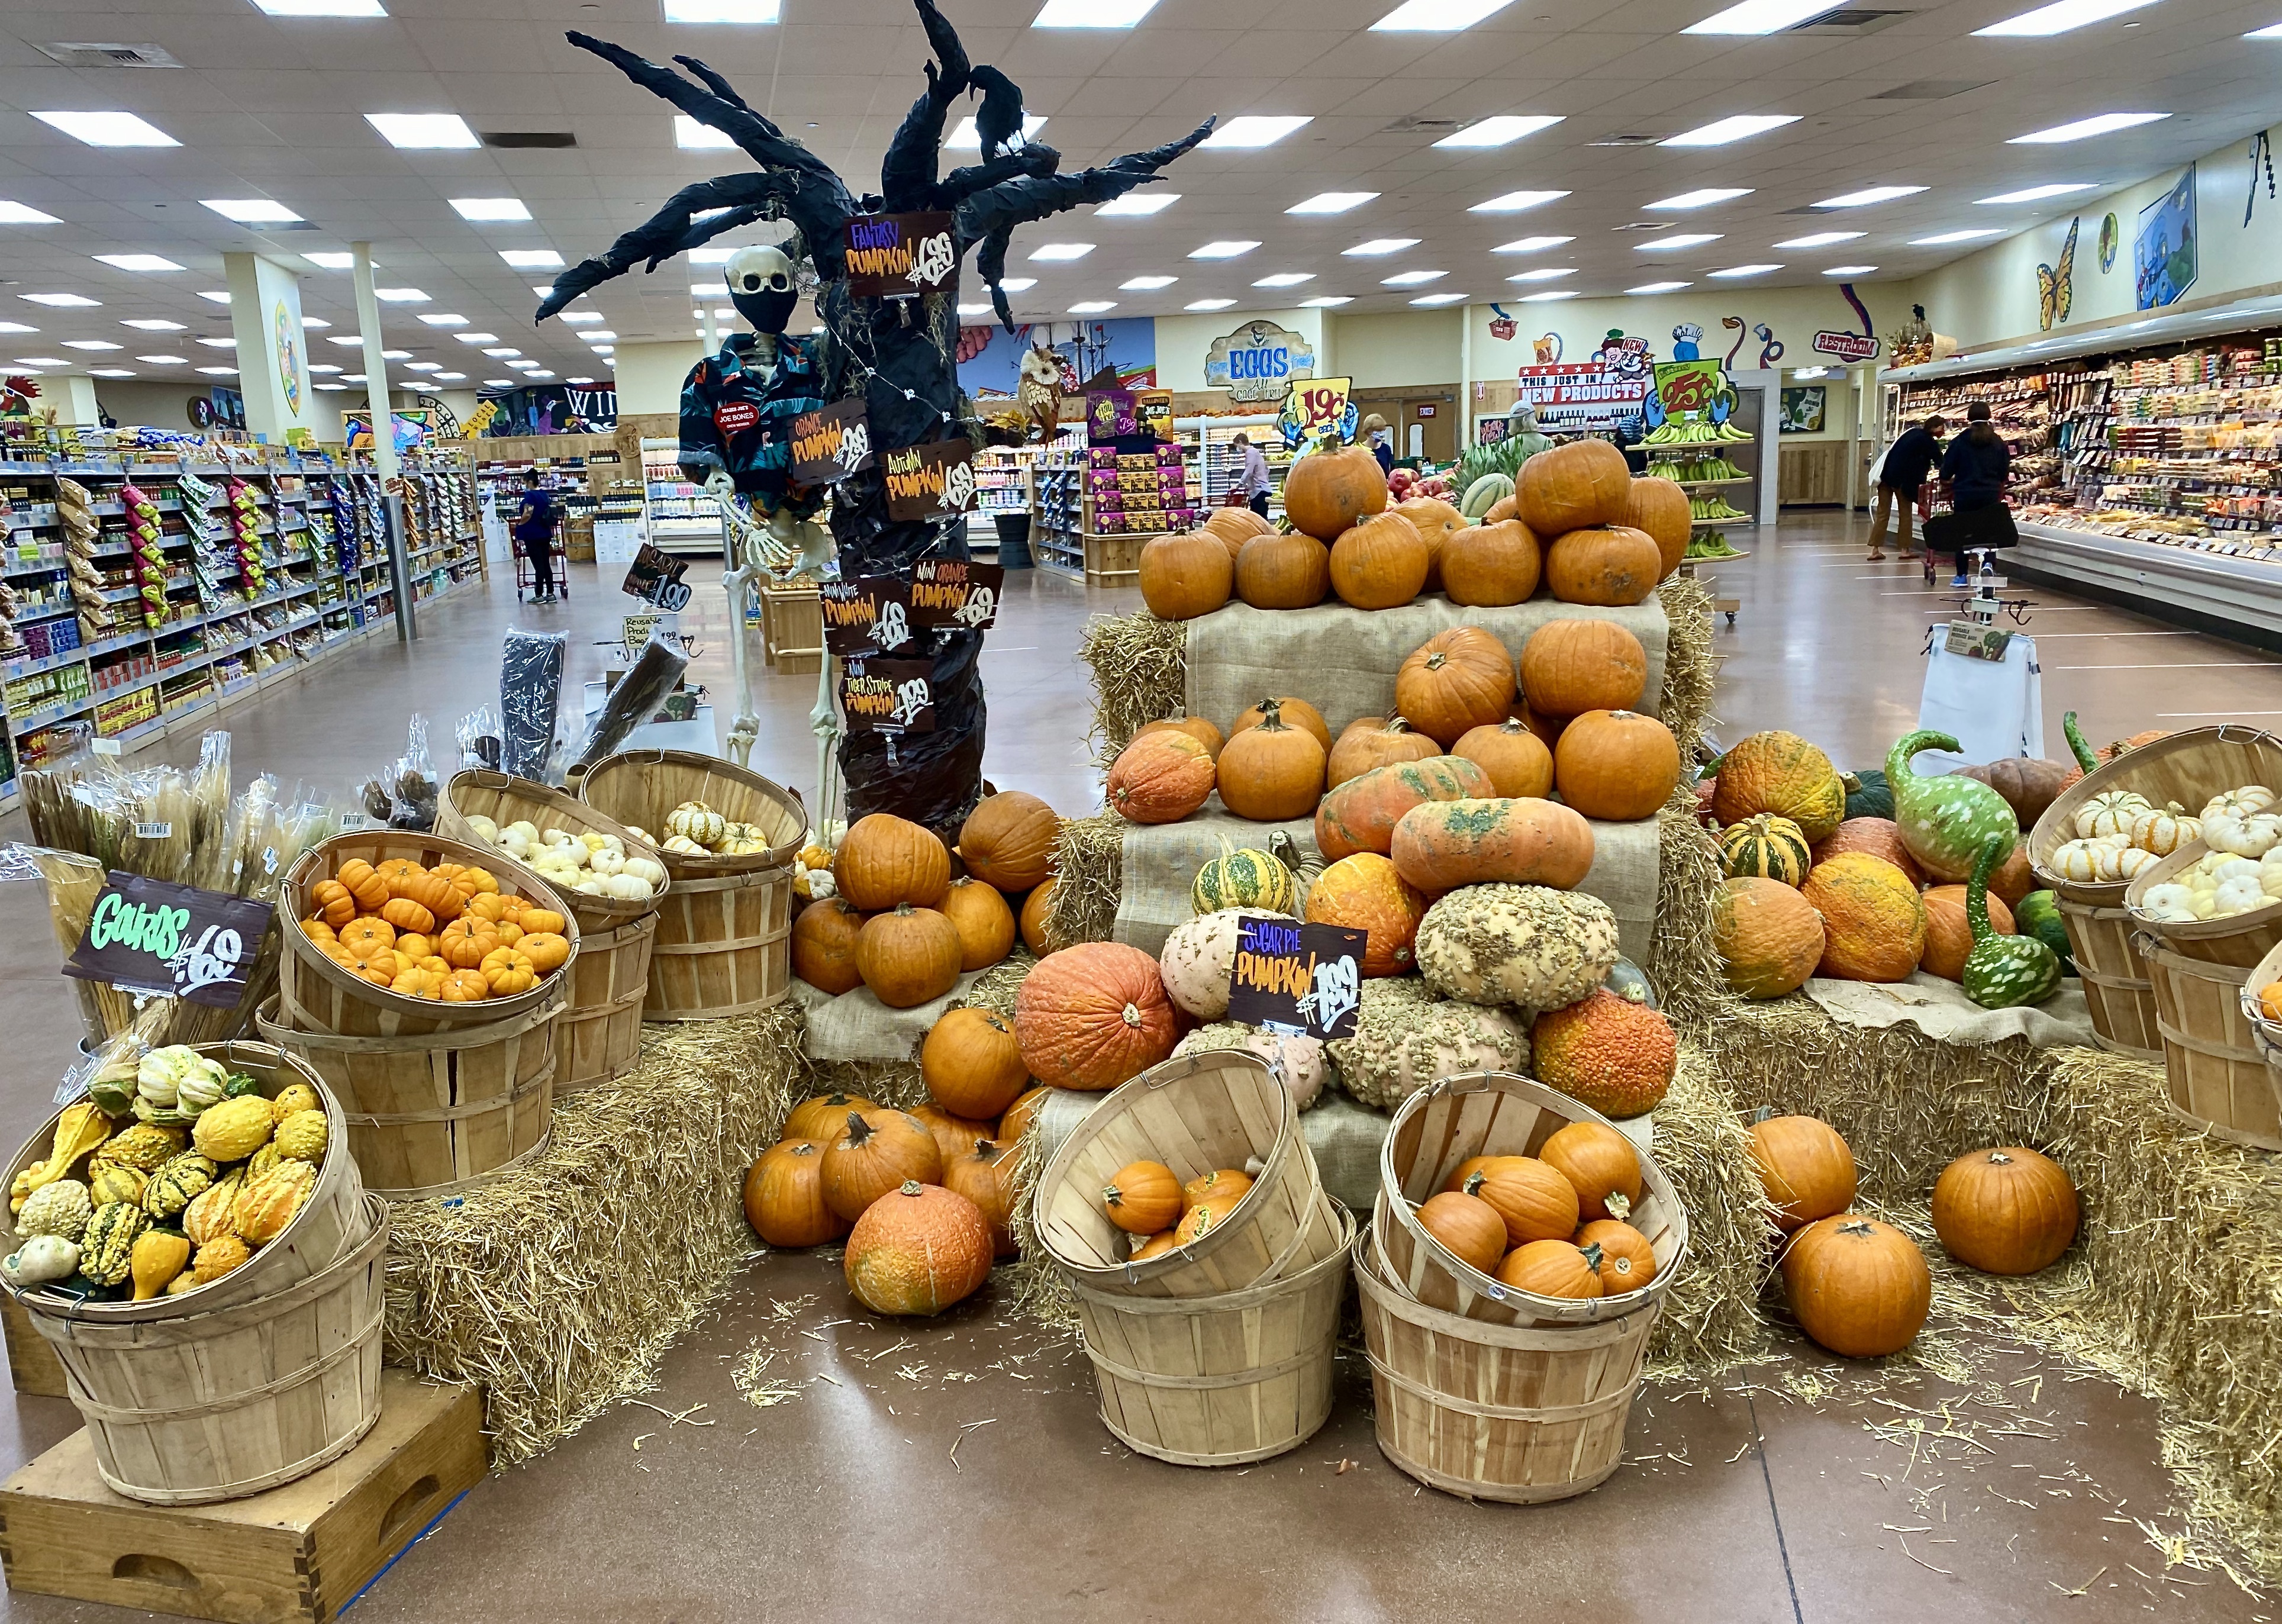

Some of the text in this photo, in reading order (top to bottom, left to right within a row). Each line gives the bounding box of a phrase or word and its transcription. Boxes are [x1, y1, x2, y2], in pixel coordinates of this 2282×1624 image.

[851, 219, 899, 249] FANTASY
[846, 238, 912, 277] PUMPKIN
[1623, 339, 1645, 352] NEW
[1818, 334, 1875, 356] RESTROOM
[1229, 347, 1288, 379] EGGS
[1522, 377, 1546, 387] THIS
[1554, 375, 1579, 386] JUST
[1236, 389, 1258, 399] CAGE
[1522, 383, 1642, 403] NEW PRODUCTS
[468, 404, 491, 427] LOCAL
[733, 412, 754, 421] BONES
[795, 412, 821, 438] ORANGE
[1318, 424, 1335, 434] each
[792, 418, 843, 465] PUMPKIN
[888, 447, 922, 474] AUTUMN
[887, 460, 945, 501] PUMPKIN
[917, 560, 969, 583] MINI ORANGE
[911, 583, 969, 610] PUMPKIN
[824, 592, 876, 626] PUMPKIN
[626, 617, 662, 626] Reusable
[626, 626, 650, 635] Produ
[848, 659, 865, 678] MINI
[845, 675, 892, 695] TIGER STRIPE
[845, 690, 894, 716] PUMPKIN
[1244, 922, 1301, 956] SUGAR PIE
[1237, 951, 1316, 1000] PUMPKIN
